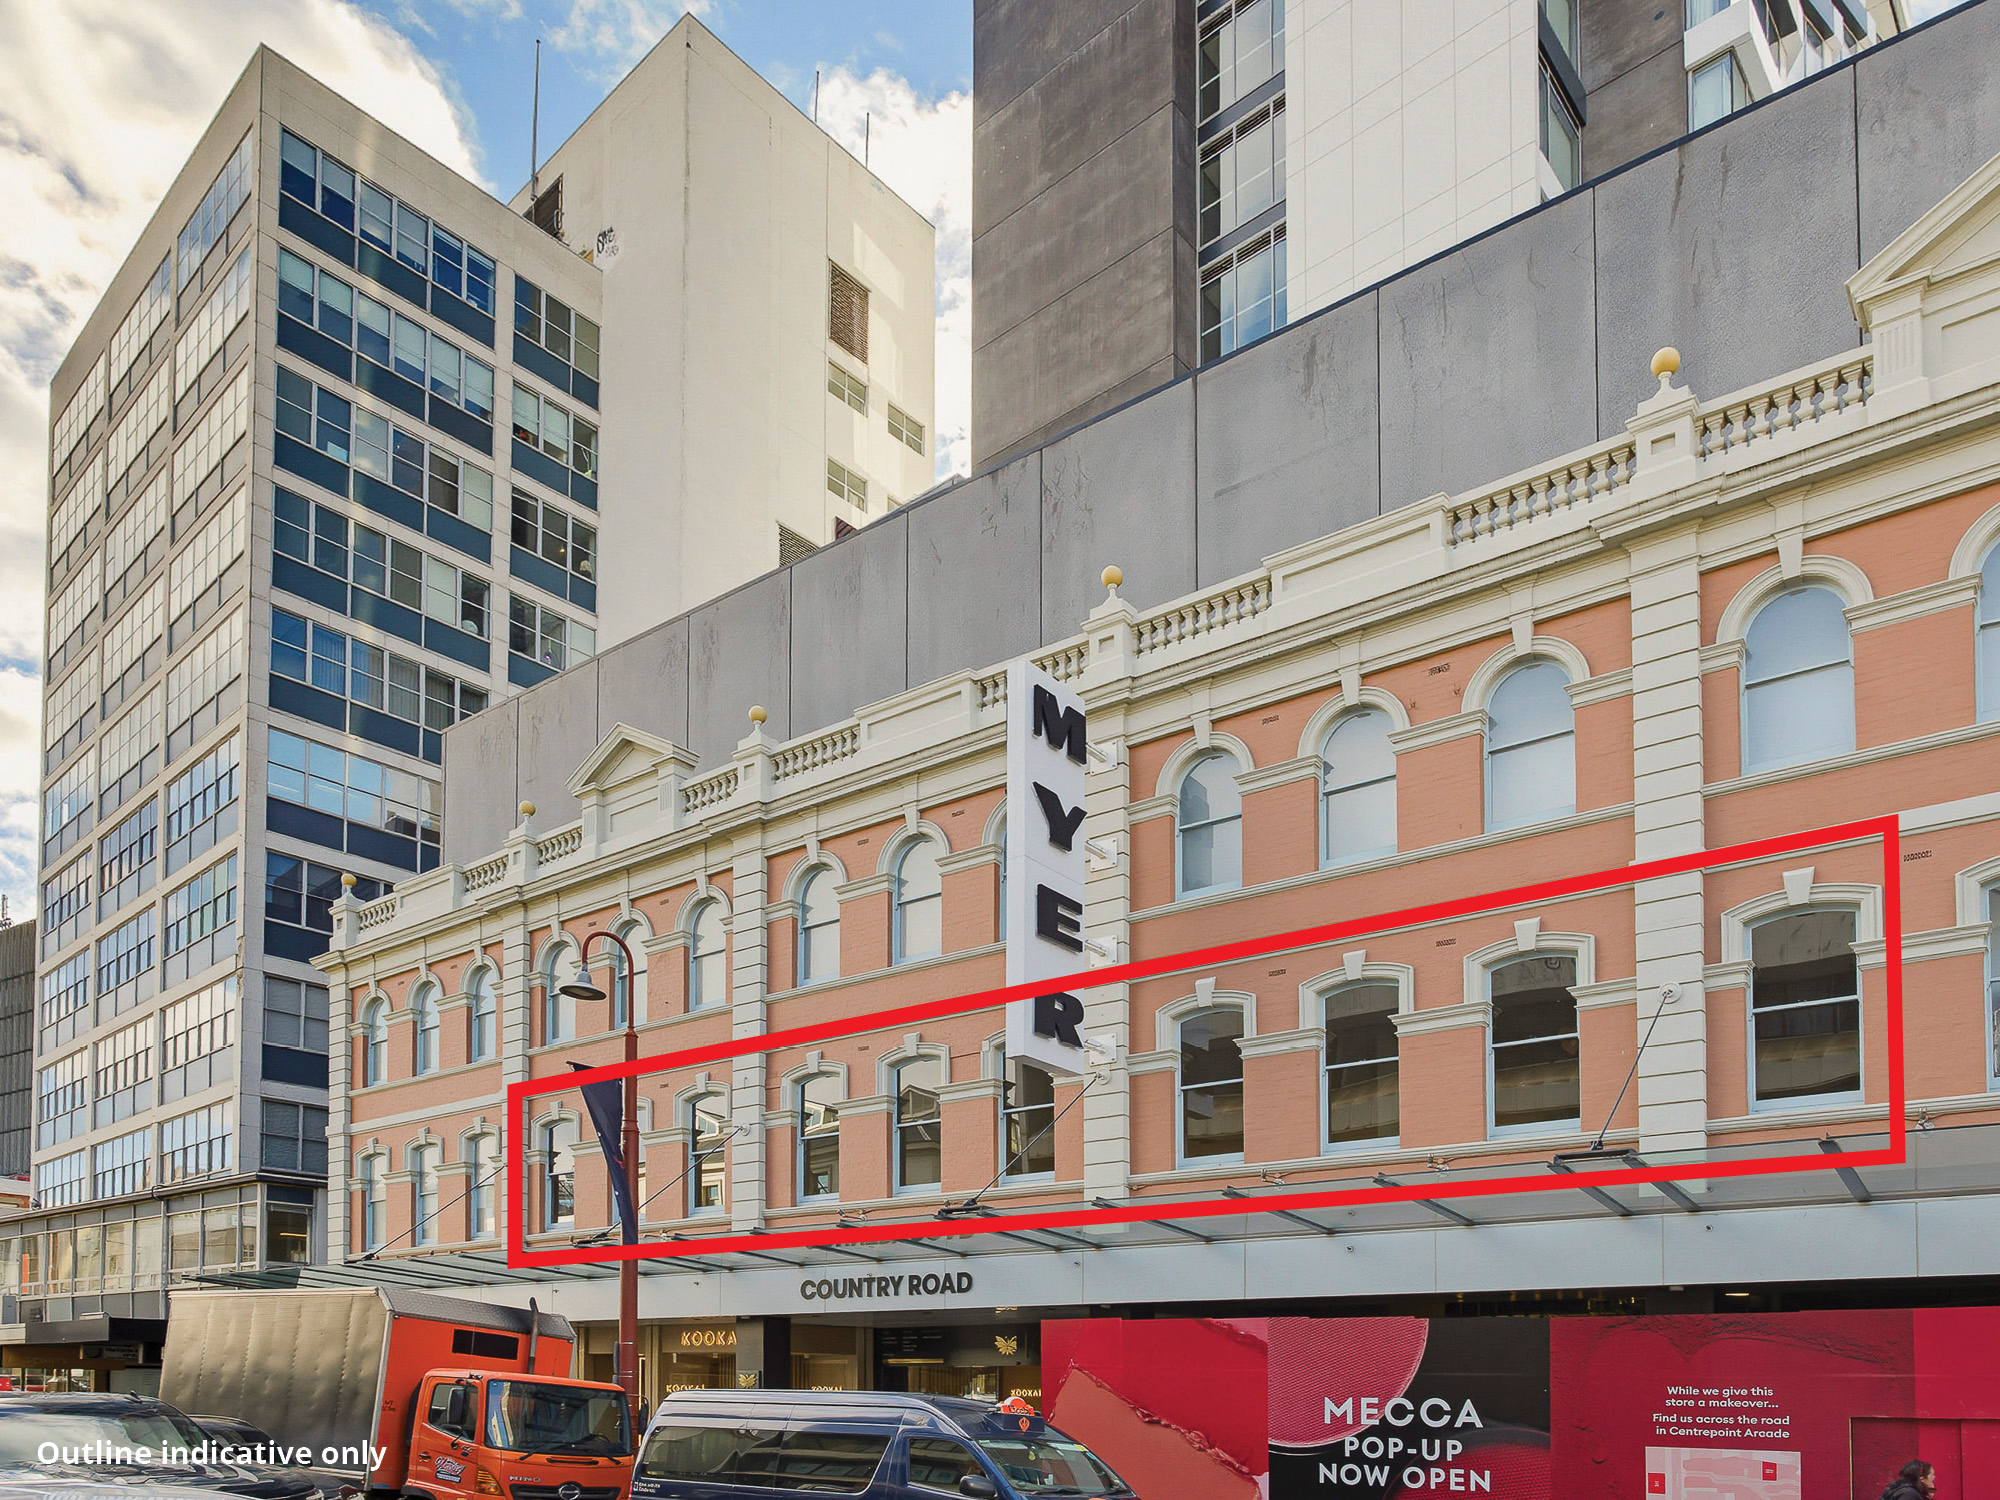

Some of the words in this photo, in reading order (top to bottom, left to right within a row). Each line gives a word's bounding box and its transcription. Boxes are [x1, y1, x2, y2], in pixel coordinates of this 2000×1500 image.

[1032, 683, 1087, 1049] MYER
[800, 1274, 904, 1300] COUNTRY
[908, 1272, 973, 1296] ROAD
[1665, 1398, 1695, 1407] store
[1708, 1398, 1779, 1408] makeover...
[1667, 1386, 1700, 1396] While
[1702, 1388, 1720, 1396] we
[1722, 1387, 1748, 1398] give
[1750, 1387, 1774, 1396] this
[1323, 1397, 1484, 1428] MECCA
[1652, 1413, 1677, 1423] Find
[1695, 1415, 1735, 1424] across
[1737, 1415, 1758, 1425] the
[1760, 1416, 1790, 1425] road
[1655, 1425, 1667, 1435] in
[1669, 1426, 1742, 1438] Centrepoint
[1744, 1428, 1790, 1438] Arcade
[1344, 1436, 1463, 1462] POP-UP
[1318, 1463, 1390, 1487] NOW
[1402, 1466, 1491, 1492] OPEN
